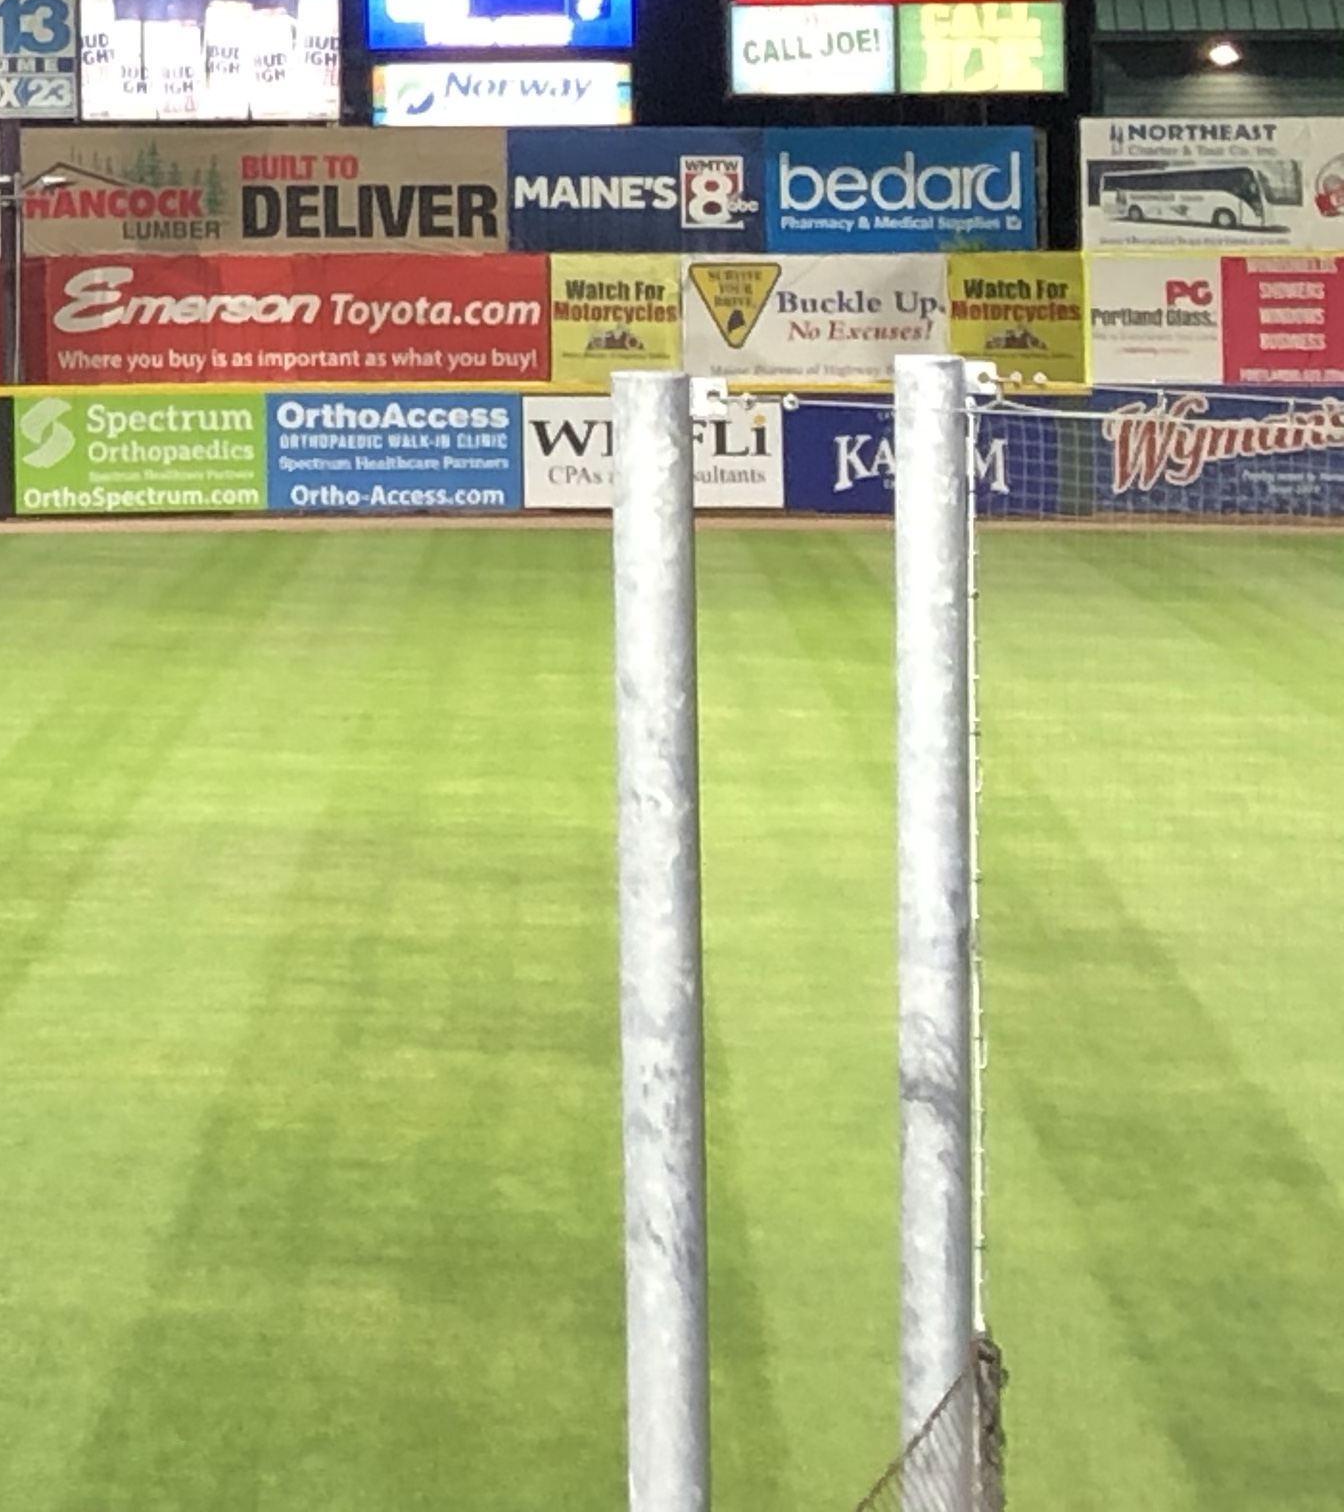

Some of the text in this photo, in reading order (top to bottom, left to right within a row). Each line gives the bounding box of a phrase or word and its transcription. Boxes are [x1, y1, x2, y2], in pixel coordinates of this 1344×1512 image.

[920, 3, 1042, 38] CALL
[743, 27, 881, 66] CALL JOE!
[1127, 123, 1278, 141] NORTHEAST
[240, 155, 359, 180] BUILT TO
[685, 159, 739, 171] WMTW
[514, 174, 679, 210] MAINE'S
[779, 150, 1023, 212] bedard
[25, 188, 206, 219] HANCOCK
[689, 170, 735, 225] 8
[241, 184, 500, 240] DELIVER
[781, 216, 855, 233] Pharmacy
[873, 215, 934, 231] Medical
[122, 220, 222, 241] LUMBER
[52, 266, 542, 334] Emerson Toyota.com
[565, 279, 667, 301] Watch For
[962, 278, 1070, 300] Watch For
[1165, 279, 1213, 307] PG
[553, 301, 679, 325] Motorcycles
[776, 290, 882, 314] Buckle
[950, 300, 1082, 323] Motorcycles
[1090, 308, 1163, 327] Portland
[787, 319, 934, 342] No Excuses!
[57, 349, 124, 370] Where
[127, 353, 164, 373] you
[169, 349, 207, 373] buy
[212, 349, 228, 369] is
[231, 353, 254, 369] as
[258, 349, 360, 373] important
[364, 353, 387, 369] as
[392, 349, 443, 369] what
[447, 352, 487, 373] you
[491, 349, 538, 373] buy!
[86, 403, 254, 438] Spectrum
[276, 400, 510, 430] OrthoAccess
[87, 440, 256, 465] Orthopaedics
[279, 433, 508, 450] ORTHOPAEDIC WALK-IN CLINIC
[278, 455, 510, 472] Spectrum Healthcare Partners
[548, 464, 603, 485] CPAs
[23, 486, 260, 511] OrthoSpectrum.com
[289, 484, 505, 507] Ortho-Access.com
